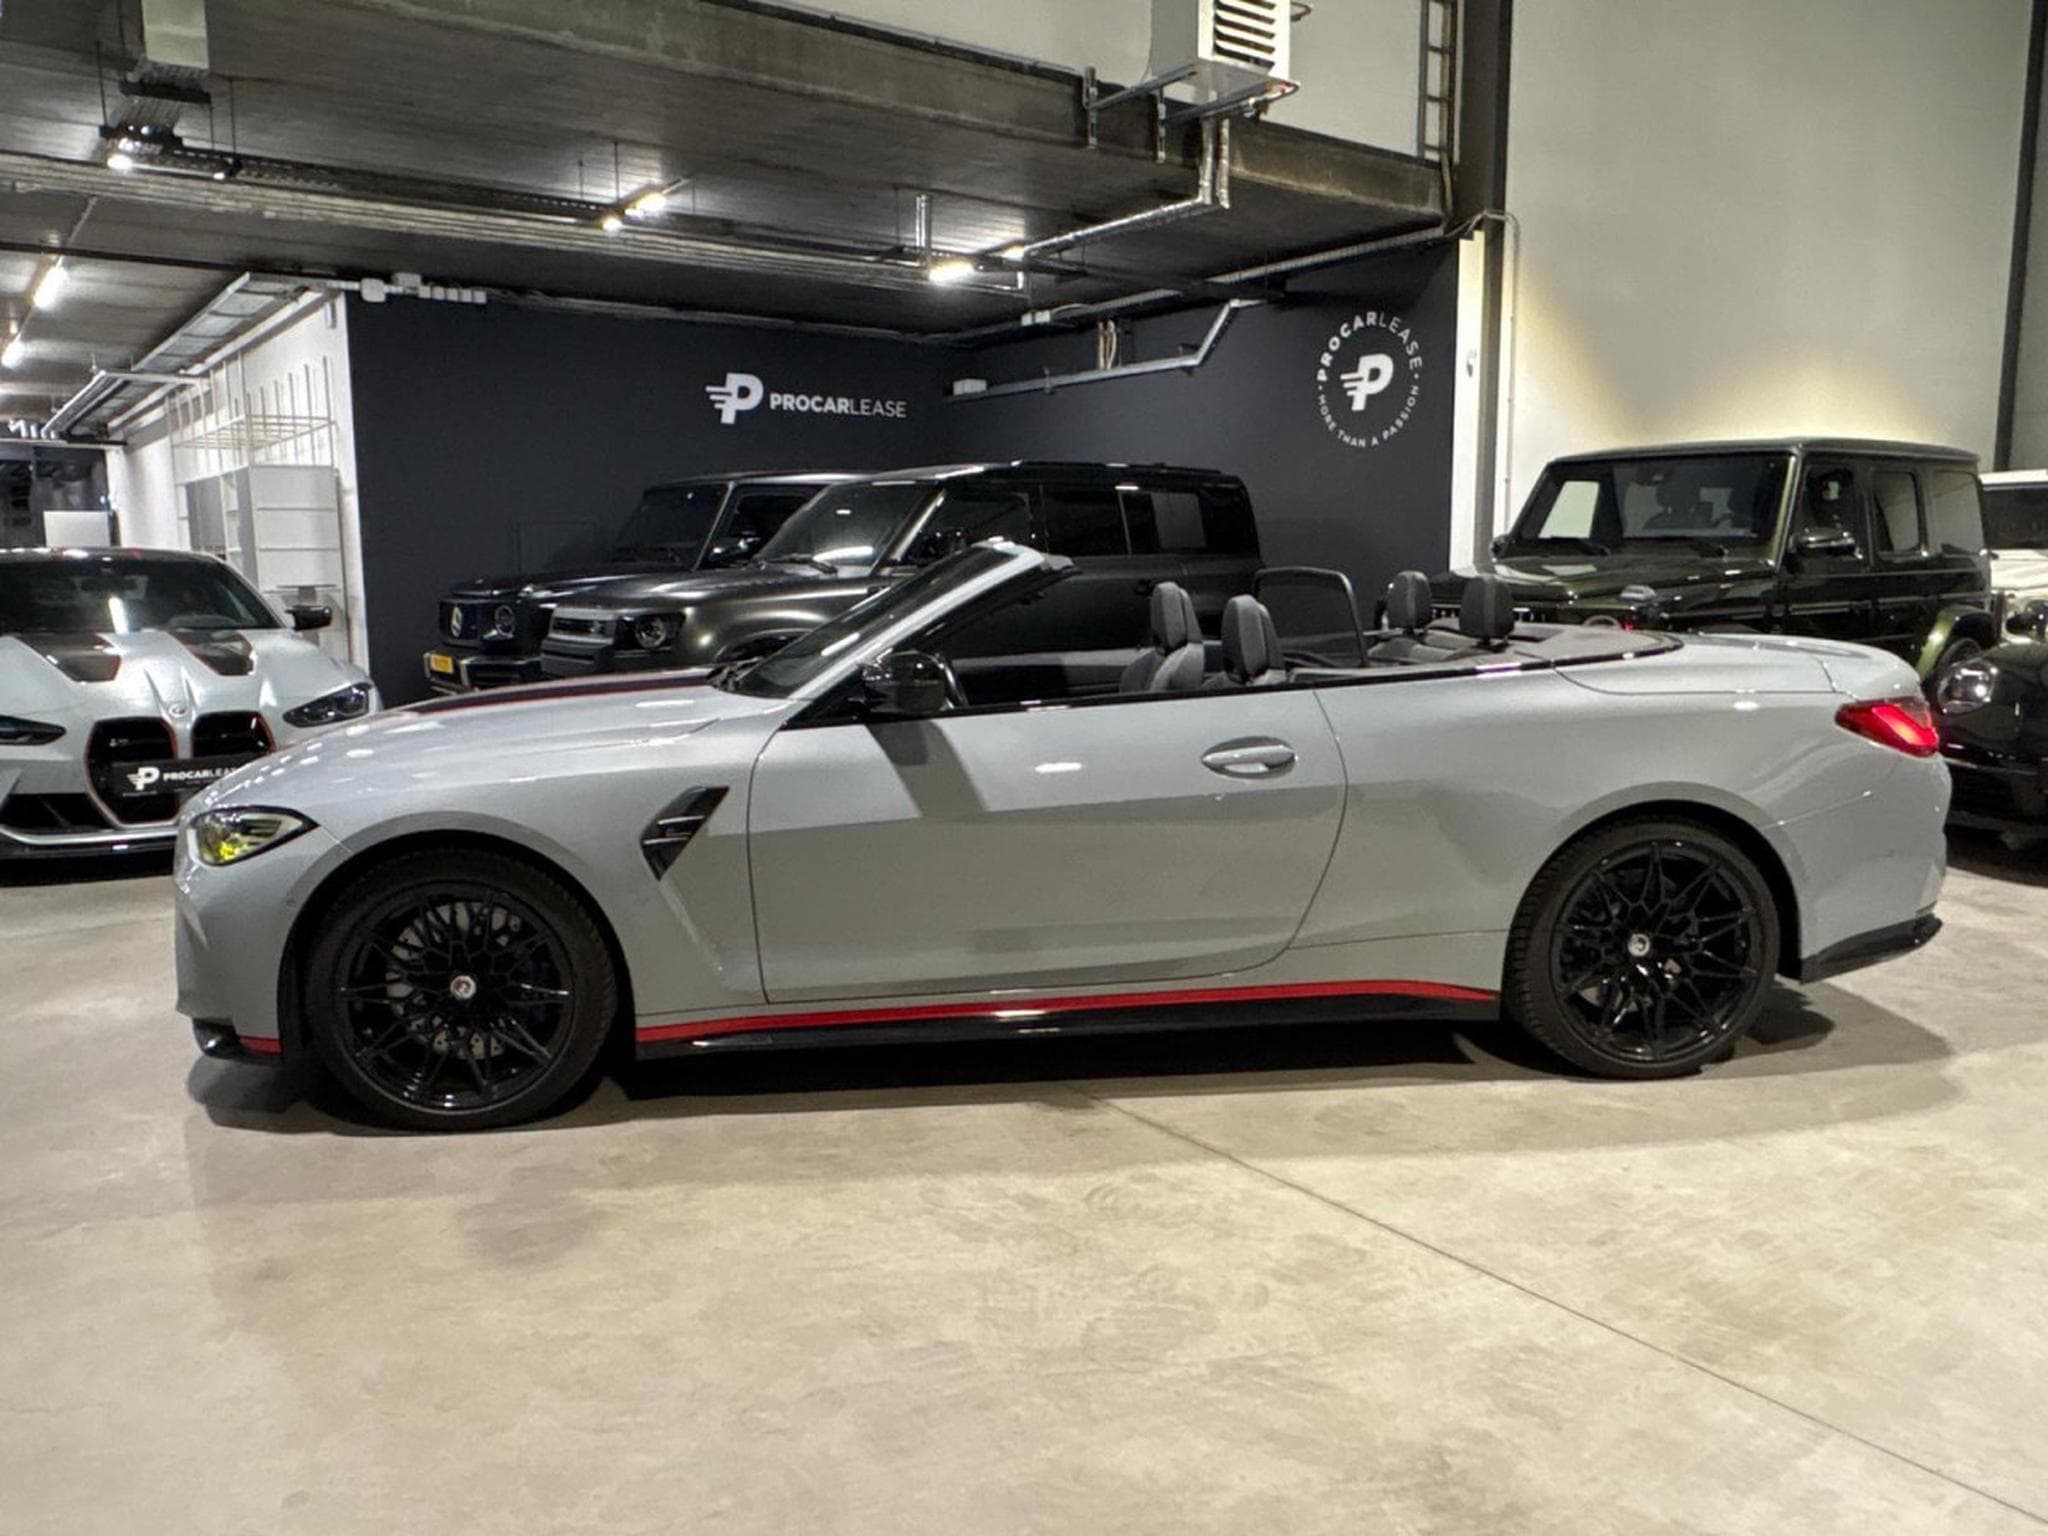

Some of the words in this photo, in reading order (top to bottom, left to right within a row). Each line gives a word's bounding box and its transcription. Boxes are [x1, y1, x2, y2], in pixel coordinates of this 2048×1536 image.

[1317, 311, 1422, 381] PROCARLEASE
[770, 393, 907, 418] PROCARLEASE
[1319, 394, 1337, 431] MORE
[1337, 429, 1366, 447] THAN
[1371, 437, 1379, 447] A
